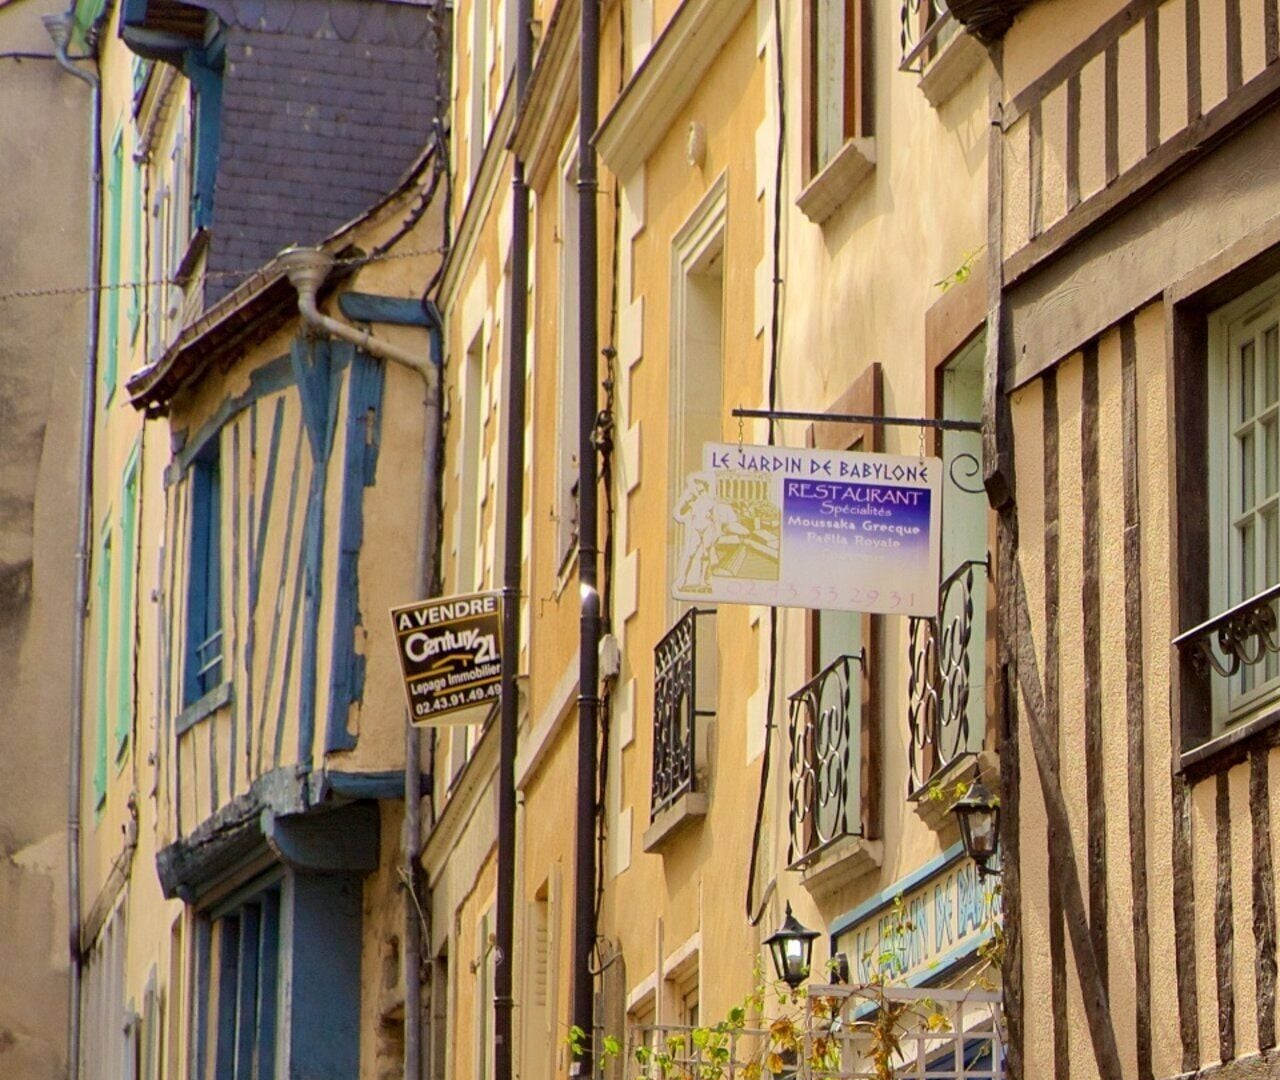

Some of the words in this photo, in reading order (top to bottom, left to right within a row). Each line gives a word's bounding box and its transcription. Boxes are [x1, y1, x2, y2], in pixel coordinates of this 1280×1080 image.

[712, 451, 730, 469] LE
[738, 453, 802, 474] JARDIN
[810, 459, 832, 476] DE
[839, 461, 929, 483] BABYLONE
[788, 483, 923, 506] RESTAURANT
[819, 501, 892, 517] Spécialités
[788, 517, 856, 531] Moussaka
[862, 521, 921, 537] Grecque
[855, 536, 901, 550] Royale
[726, 581, 757, 596] 02
[849, 587, 879, 607] 29
[888, 590, 915, 608] 31
[399, 614, 412, 631] A
[415, 597, 495, 626] VENDRE
[405, 628, 480, 663] Century
[473, 634, 497, 664] 21
[411, 678, 446, 696] Lepage
[448, 664, 501, 685] Immobilier
[416, 685, 502, 715] 02.43.91.49.49
